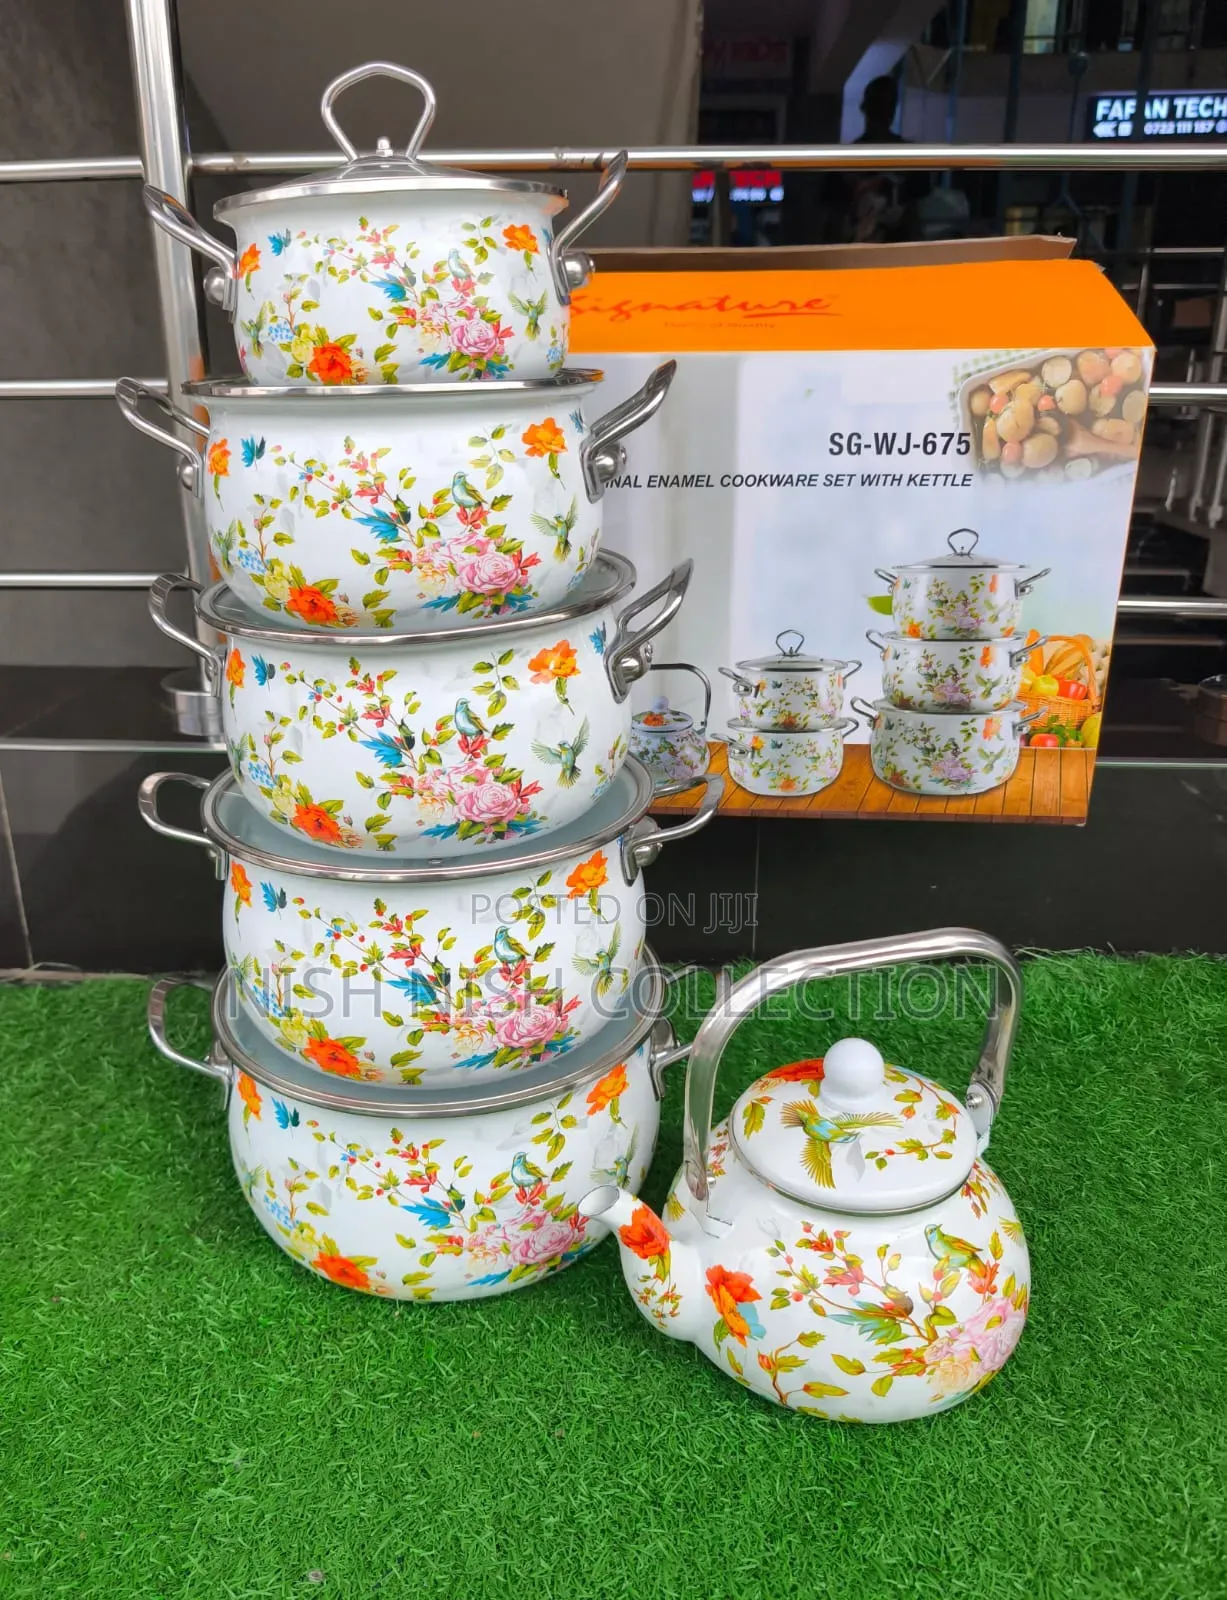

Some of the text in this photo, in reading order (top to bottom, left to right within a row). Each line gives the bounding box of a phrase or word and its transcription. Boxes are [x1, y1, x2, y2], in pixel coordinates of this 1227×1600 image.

[829, 432, 971, 456] SG-WJ-675
[646, 474, 715, 488] ENAMEL
[719, 473, 819, 488] COOKWARE
[822, 473, 857, 487] SET
[860, 473, 903, 487] WITH
[906, 473, 973, 487] KETTLE
